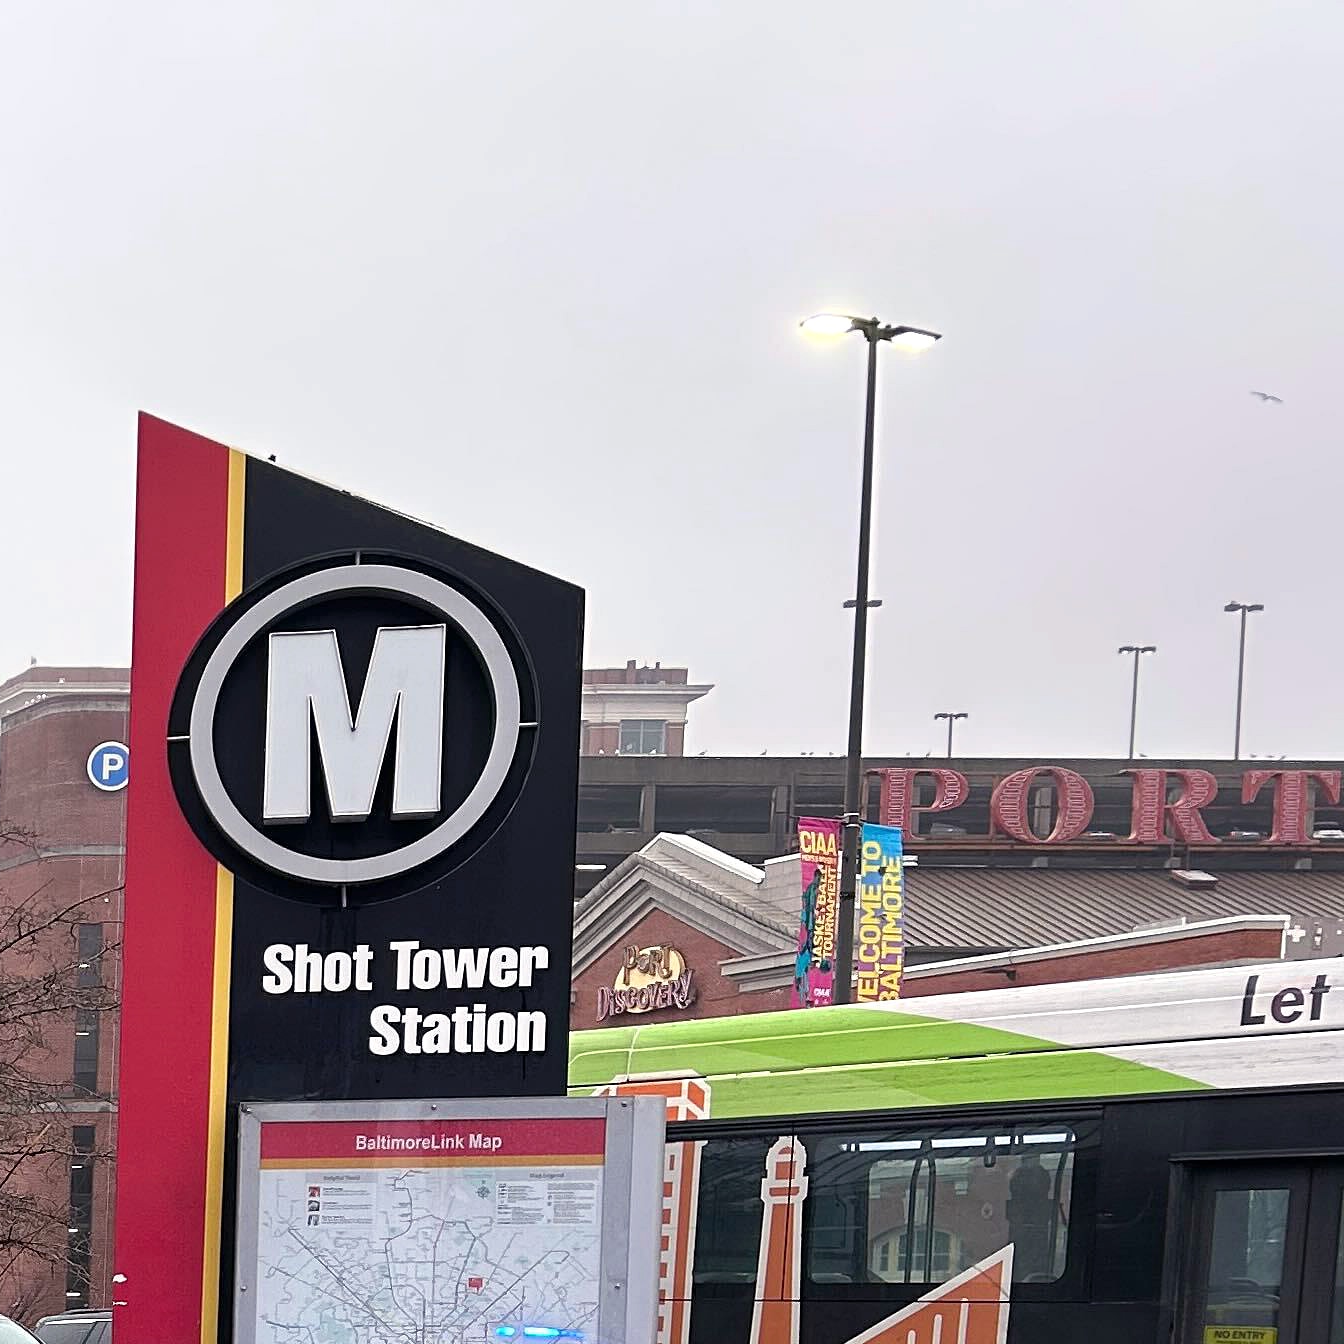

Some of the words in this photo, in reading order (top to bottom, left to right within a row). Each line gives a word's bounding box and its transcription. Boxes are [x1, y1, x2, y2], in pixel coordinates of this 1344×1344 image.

[263, 623, 446, 825] M
[103, 753, 124, 780] P
[864, 766, 1341, 846] PORT
[799, 830, 837, 857] CIAA
[861, 841, 882, 877] TO
[822, 866, 837, 959] TOURNAMENT
[262, 943, 374, 994] Shot
[389, 940, 549, 990] Tower
[1240, 974, 1332, 1026] Let
[369, 1003, 547, 1055] Station
[355, 1132, 465, 1151] BaltimoreLink
[469, 1133, 503, 1153] Map
[1214, 1330, 1230, 1339] NO
[1232, 1331, 1265, 1340] ENTRY
